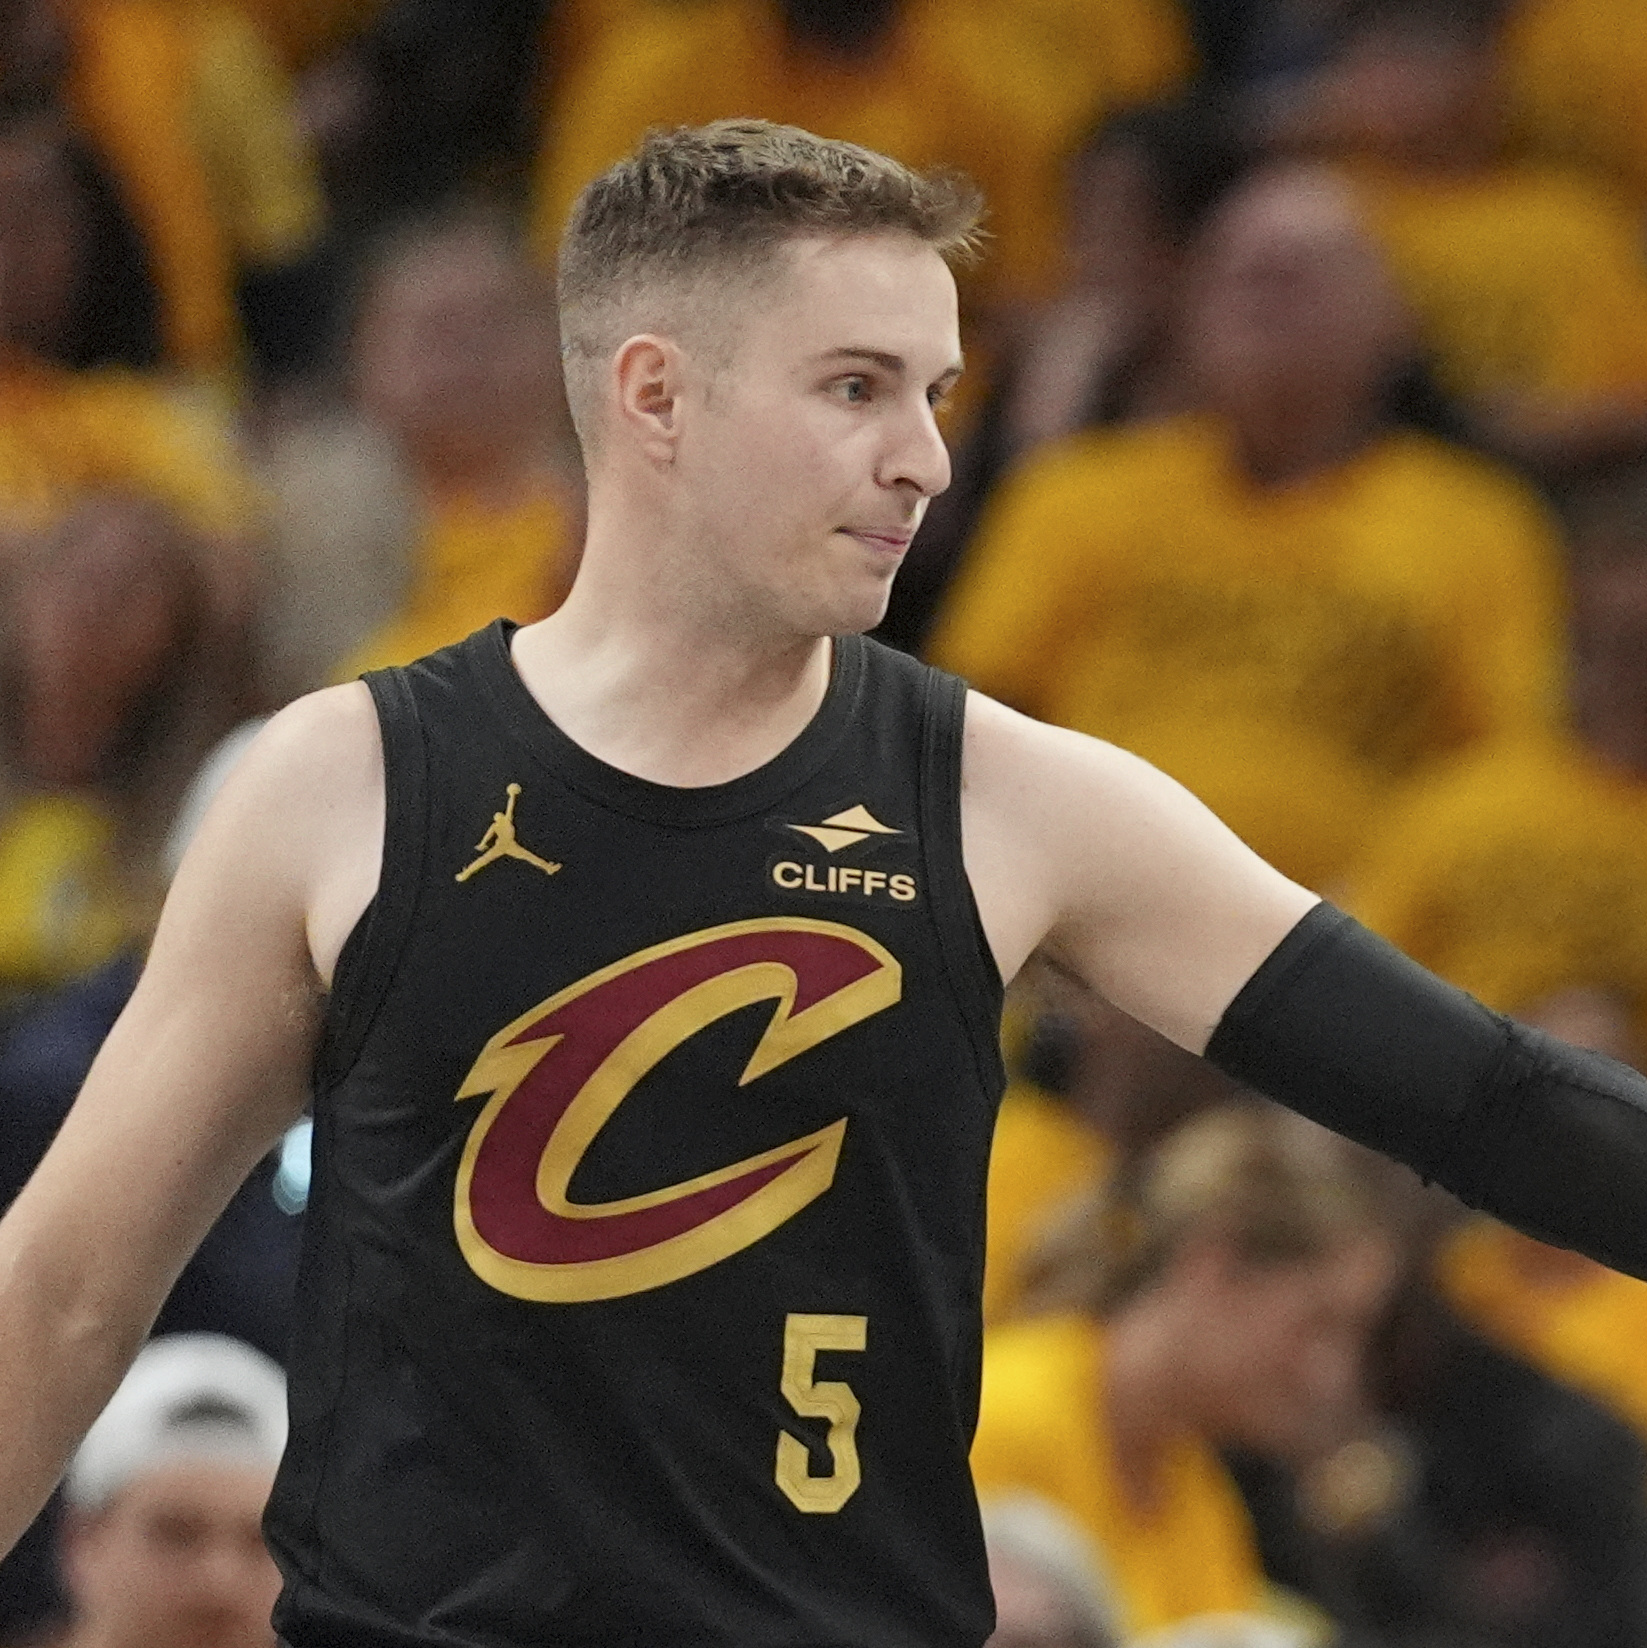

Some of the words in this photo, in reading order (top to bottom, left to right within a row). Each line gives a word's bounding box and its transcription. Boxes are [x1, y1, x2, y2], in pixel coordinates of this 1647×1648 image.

[773, 861, 917, 901] CLIFFS
[454, 916, 902, 1302] C
[776, 1313, 868, 1513] 5
